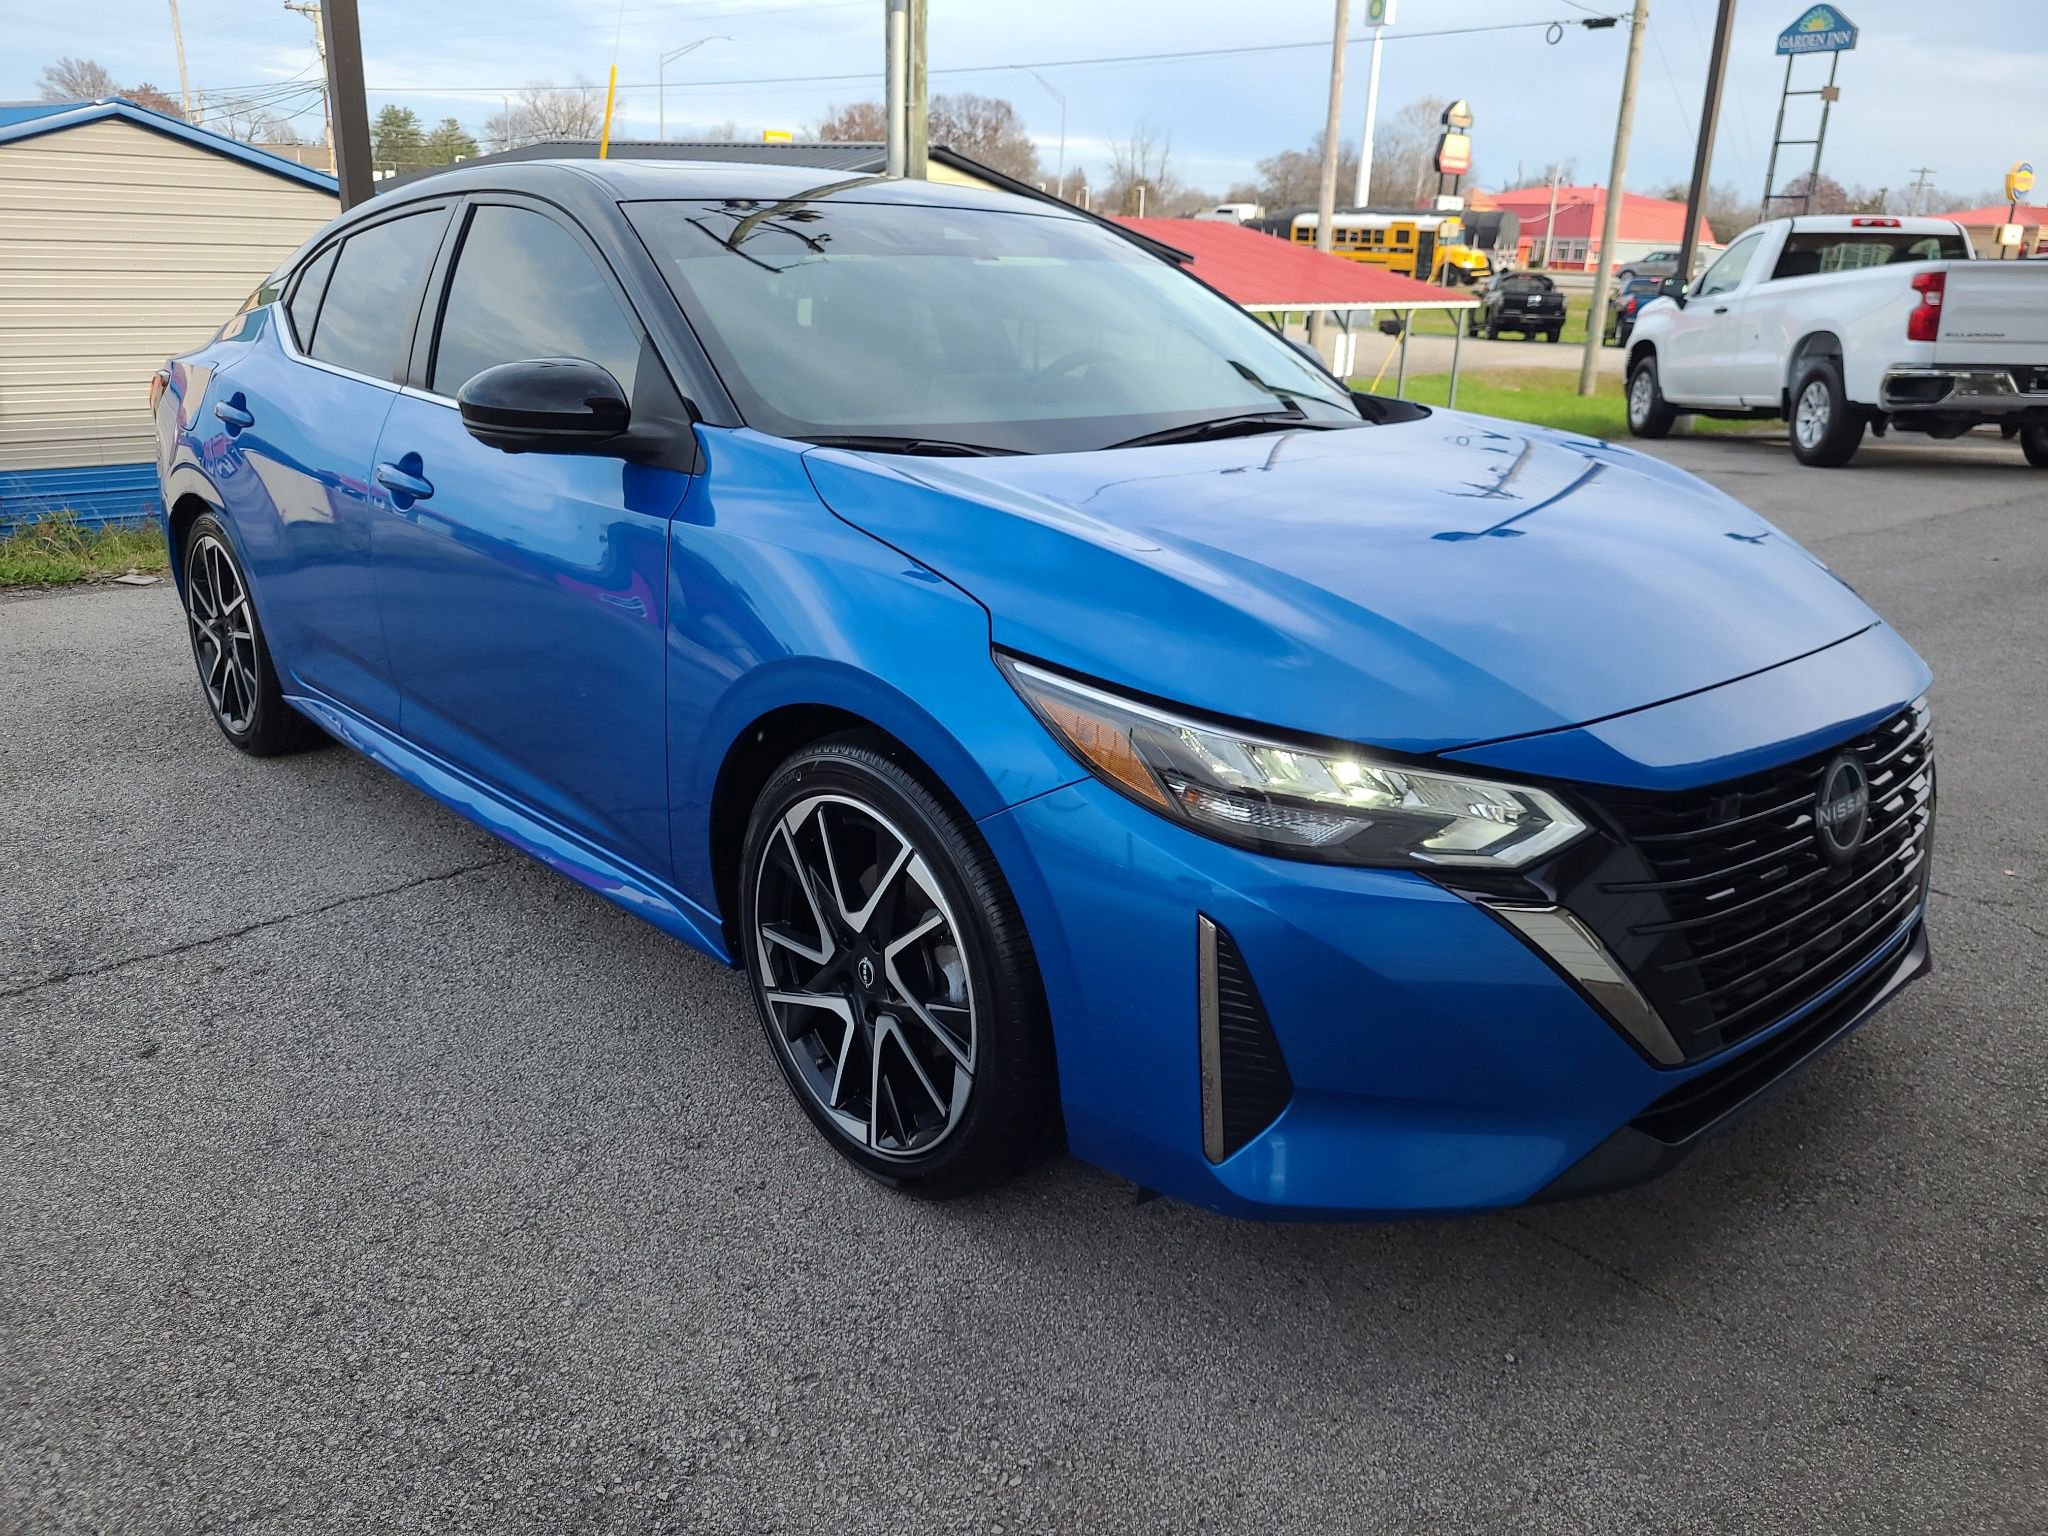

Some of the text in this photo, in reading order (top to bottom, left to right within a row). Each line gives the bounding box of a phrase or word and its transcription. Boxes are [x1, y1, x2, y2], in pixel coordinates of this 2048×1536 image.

[1779, 31, 1851, 48] GARDEN INN
[1819, 790, 1868, 825] NISSAN
